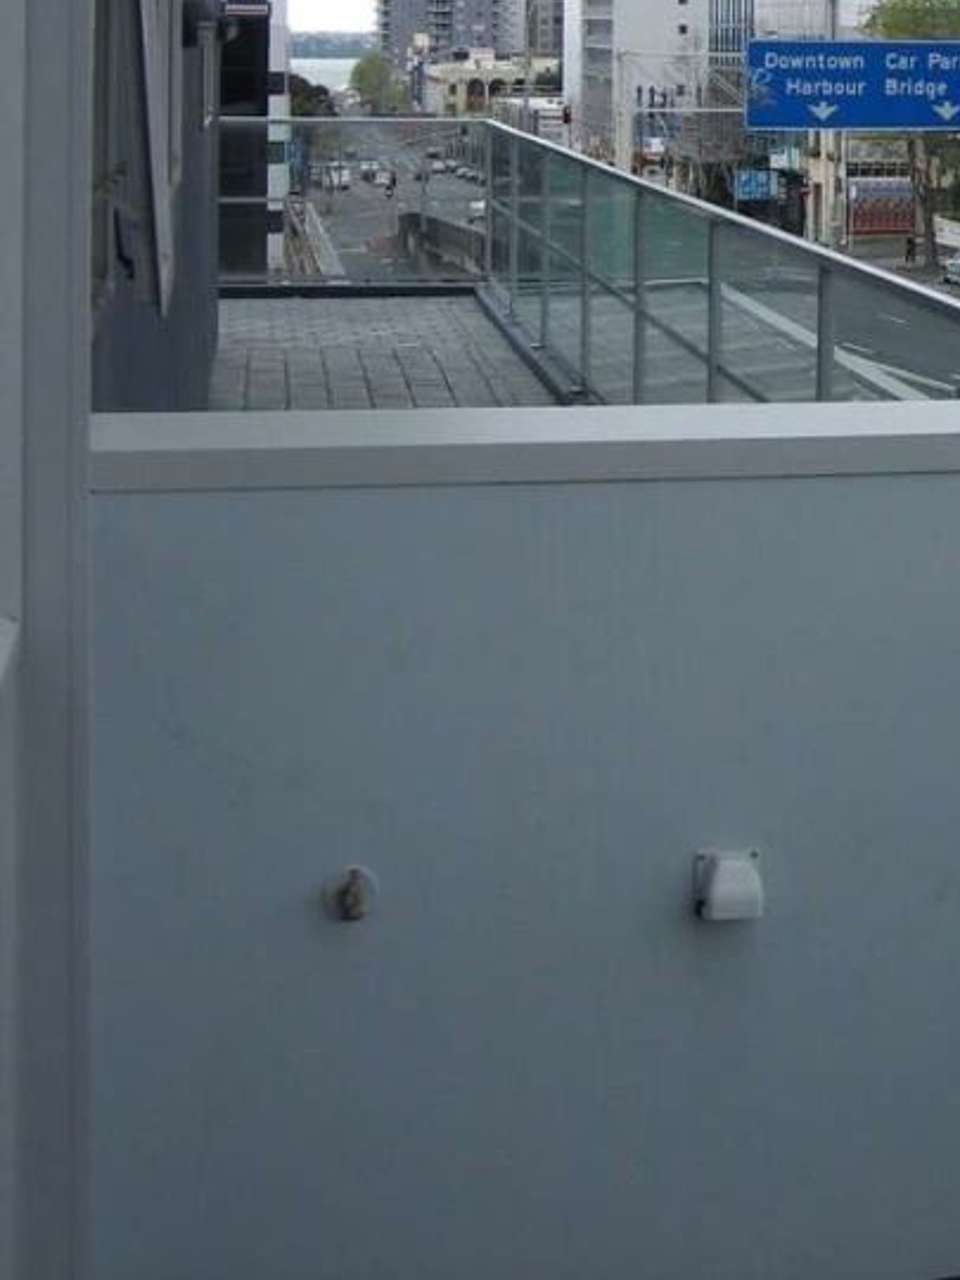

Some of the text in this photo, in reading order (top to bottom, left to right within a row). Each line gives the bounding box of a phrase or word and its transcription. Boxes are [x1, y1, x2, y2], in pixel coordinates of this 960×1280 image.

[764, 51, 864, 69] Downtown
[885, 52, 917, 69] Car
[785, 78, 866, 96] Harbour
[885, 78, 948, 100] Bridge
